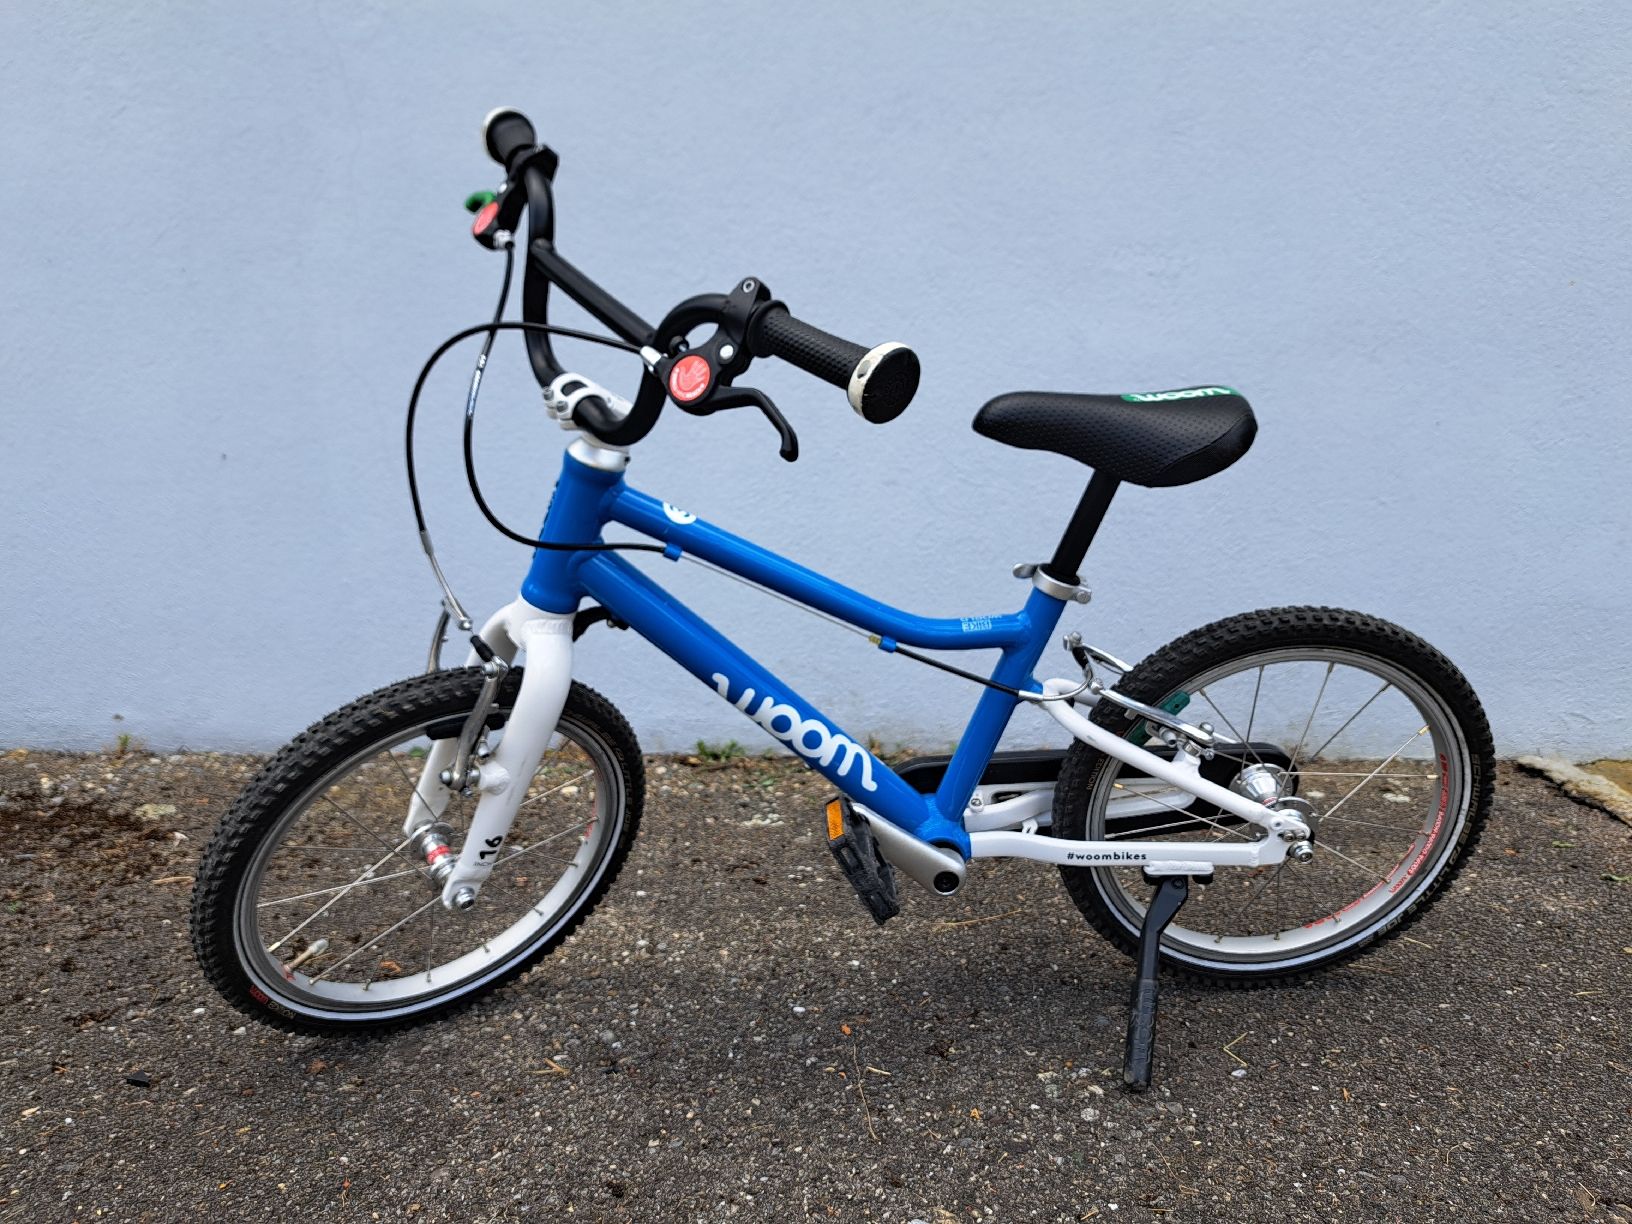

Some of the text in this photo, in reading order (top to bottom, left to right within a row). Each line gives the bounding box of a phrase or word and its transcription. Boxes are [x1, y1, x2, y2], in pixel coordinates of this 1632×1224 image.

[712, 672, 878, 792] woom
[1458, 753, 1481, 846] SCHWALBE
[479, 835, 503, 860] 16
[1067, 851, 1147, 861] #woombikes
